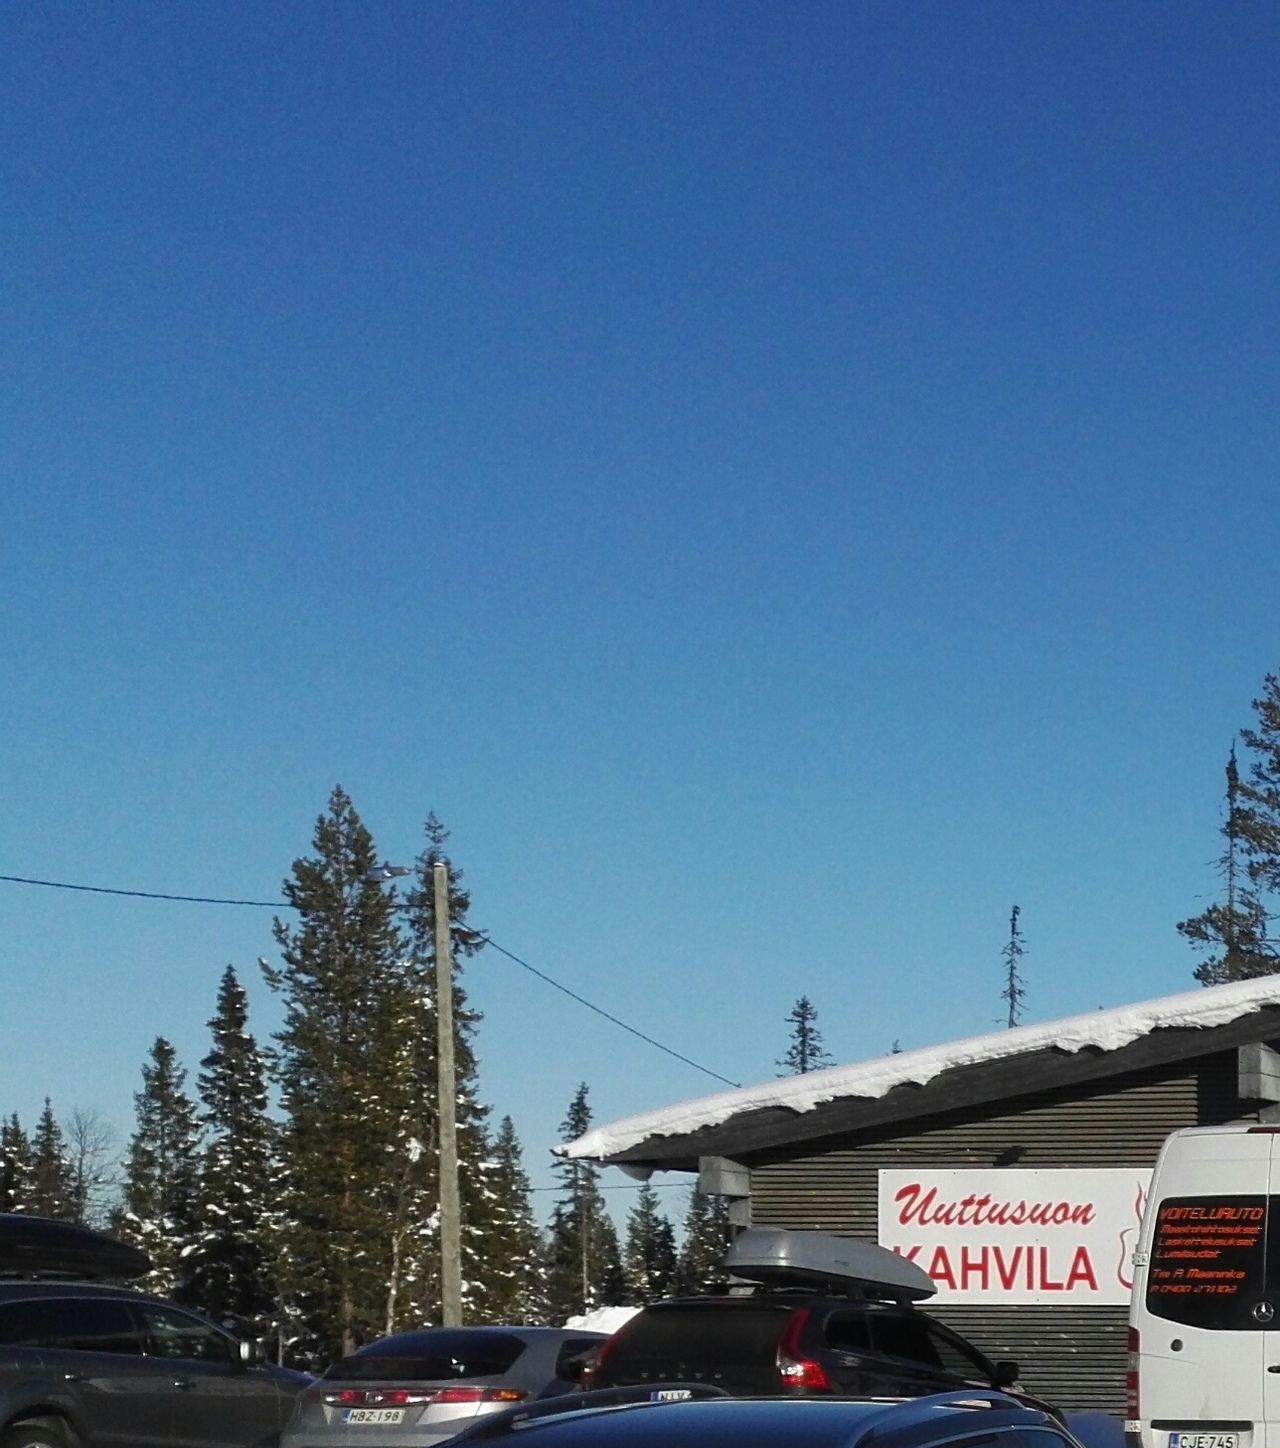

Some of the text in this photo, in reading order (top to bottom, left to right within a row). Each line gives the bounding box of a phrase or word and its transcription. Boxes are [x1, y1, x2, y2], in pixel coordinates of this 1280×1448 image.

[894, 1183, 1097, 1226] Uuttusuon
[1160, 1207, 1264, 1220] VOITELUAUTO
[350, 1411, 401, 1422] HBZ-198
